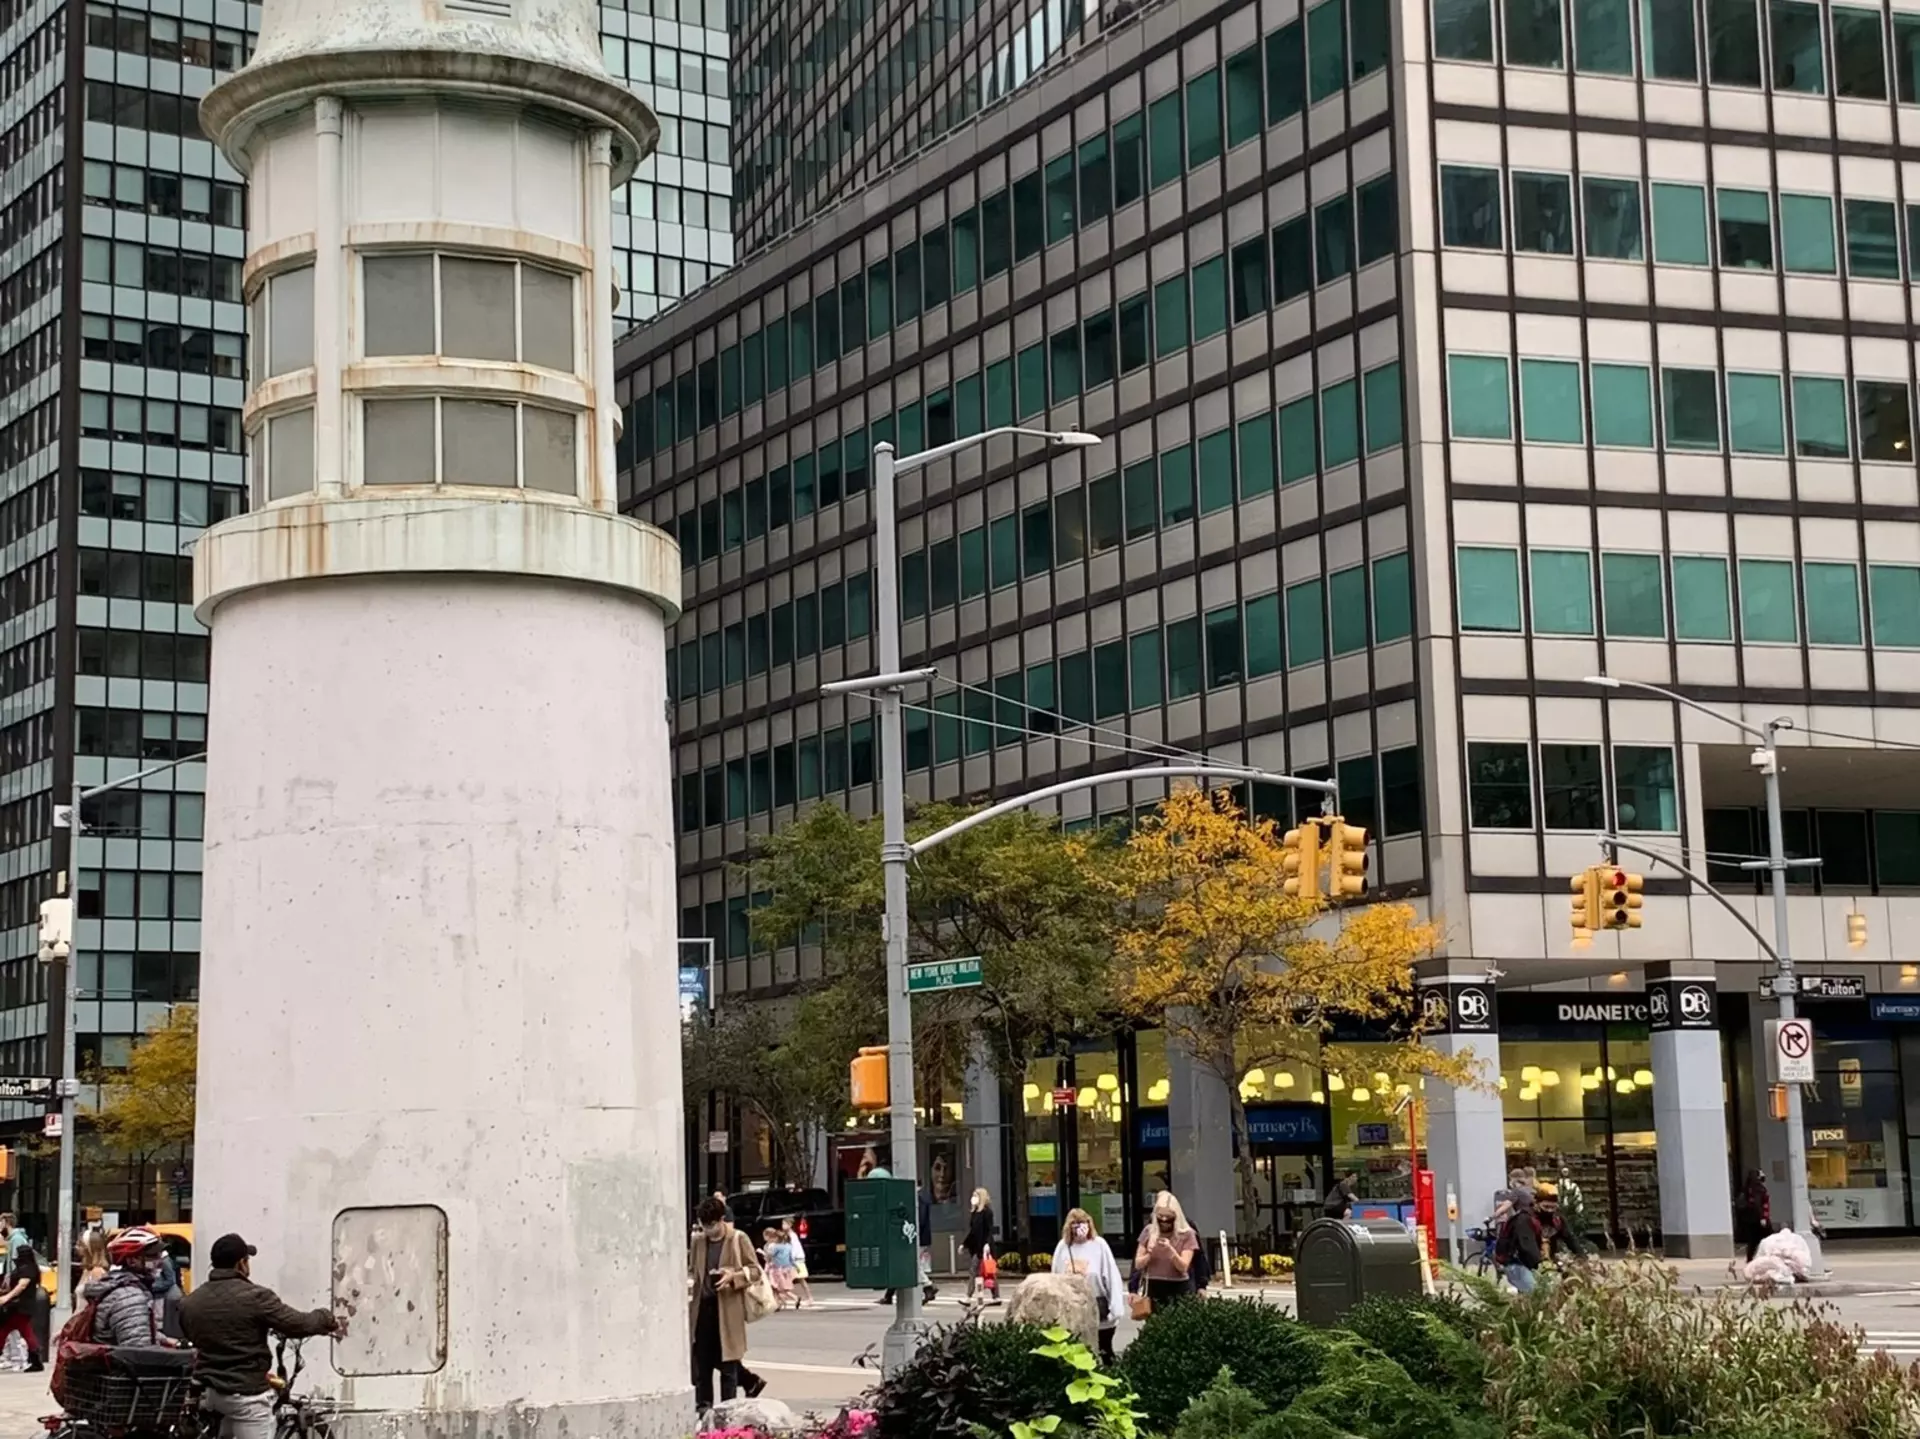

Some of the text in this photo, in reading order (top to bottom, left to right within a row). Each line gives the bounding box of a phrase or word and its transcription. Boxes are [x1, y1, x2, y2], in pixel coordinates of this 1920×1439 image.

[1821, 982, 1856, 996] Fulton
[1457, 995, 1489, 1016] DR
[1680, 992, 1710, 1013] DR
